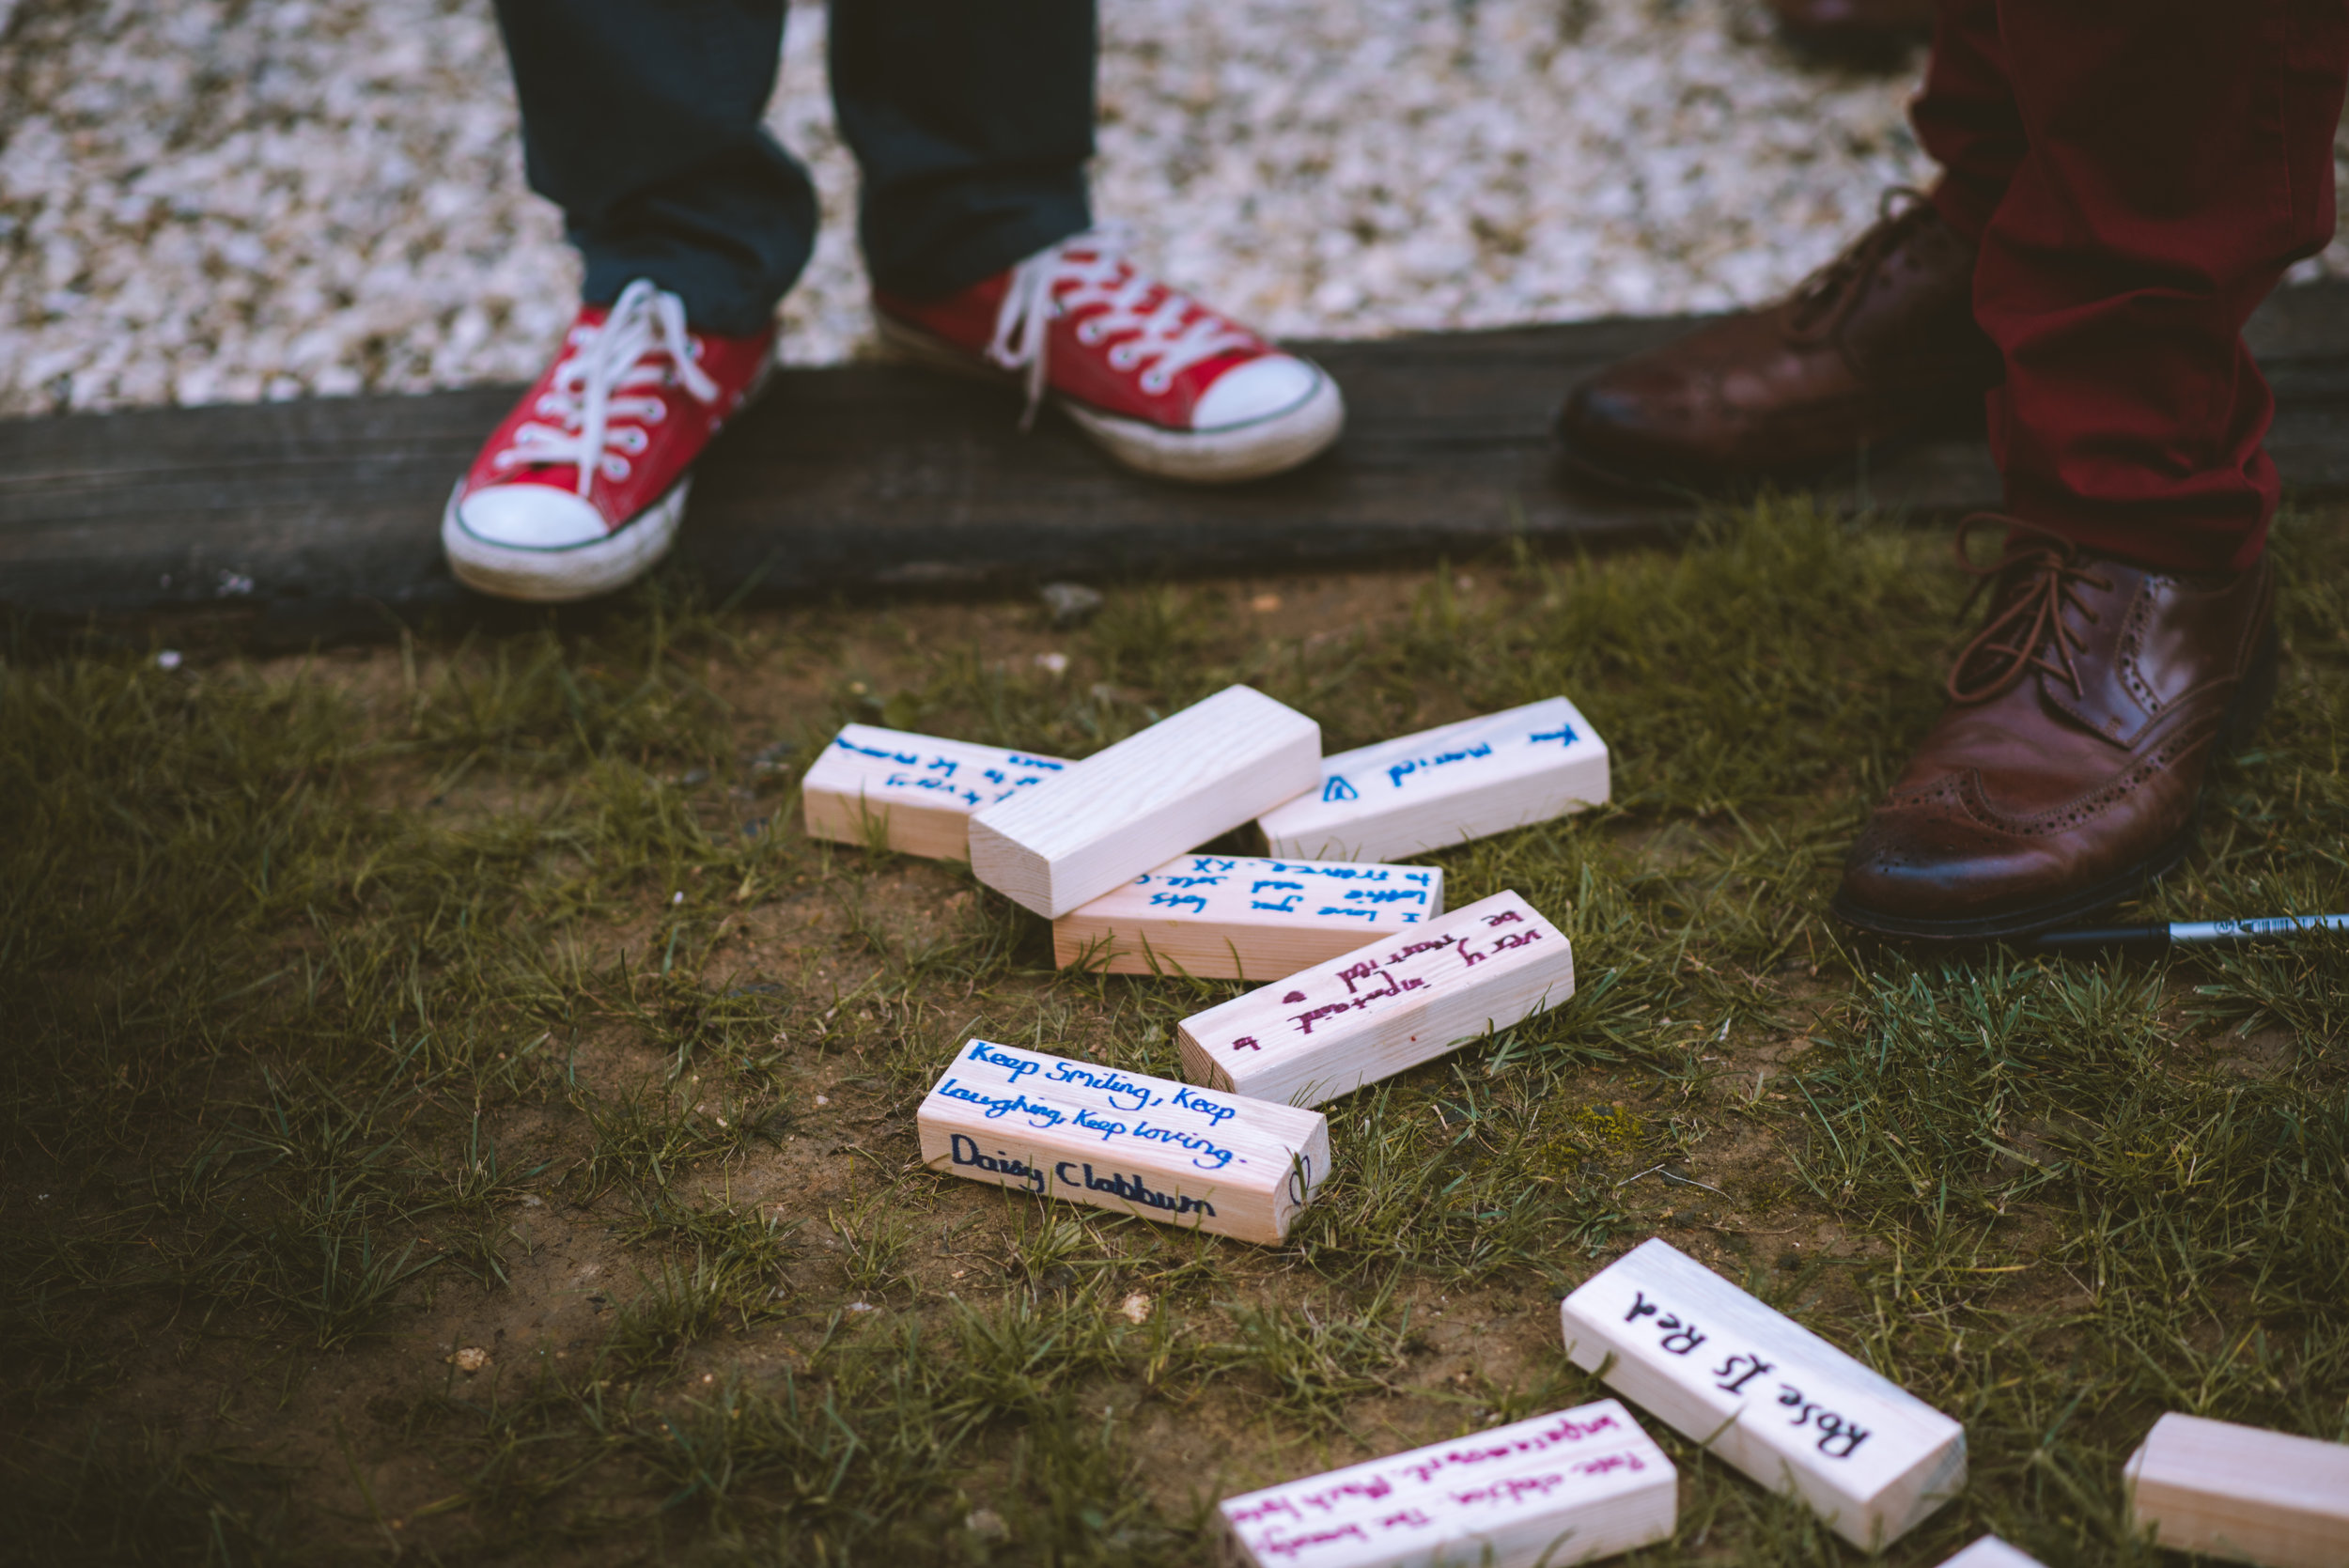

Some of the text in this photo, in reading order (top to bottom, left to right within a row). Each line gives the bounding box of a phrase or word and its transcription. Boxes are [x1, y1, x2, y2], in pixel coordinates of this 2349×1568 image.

[1252, 880, 1303, 893] and
[1406, 873, 1430, 886] to
[1251, 895, 1303, 912] you
[1402, 912, 1420, 923] I
[1336, 909, 1525, 993] be married
[1456, 929, 1542, 967] very
[1233, 1036, 1261, 1050] to
[968, 1042, 1235, 1126] Keep Smiling, Keep
[1072, 1109, 1127, 1141] Keep
[950, 1133, 1045, 1193] Daisy
[1625, 1292, 1872, 1459] Rose Is Red
